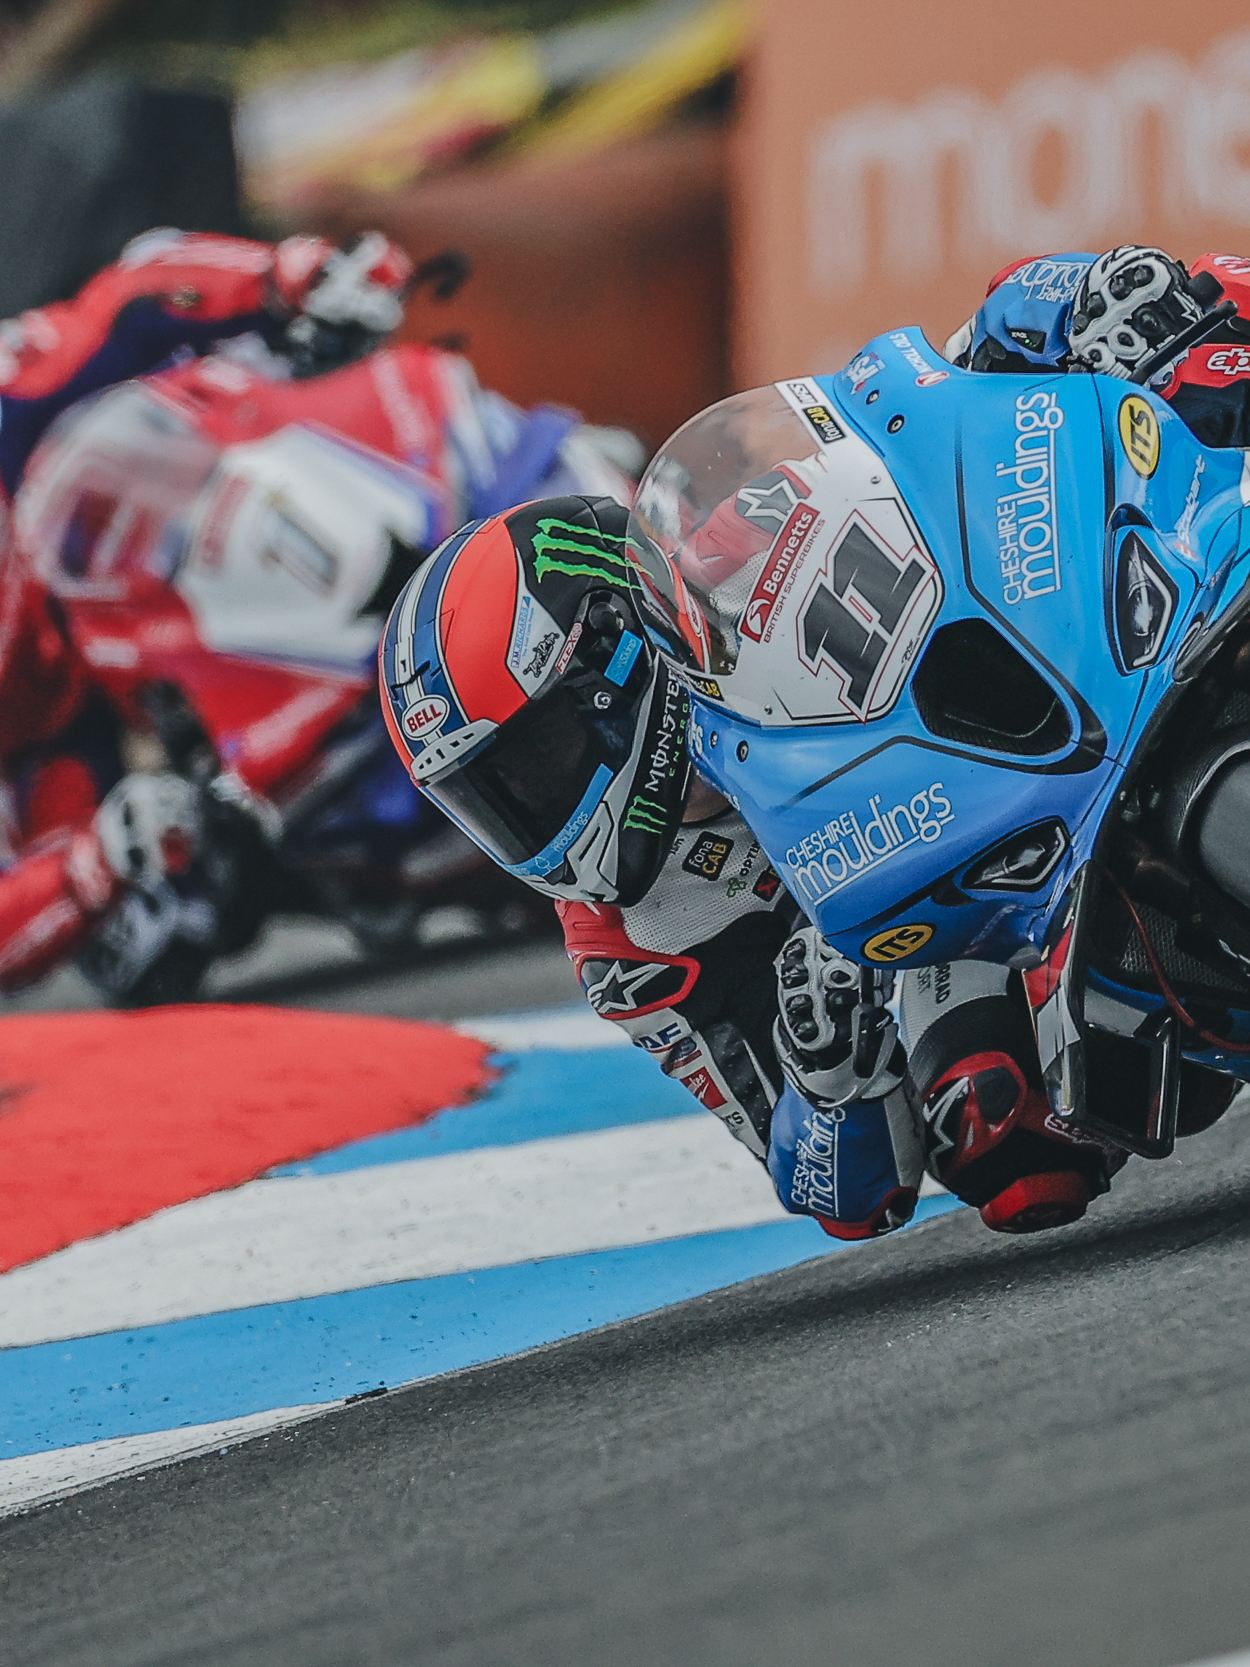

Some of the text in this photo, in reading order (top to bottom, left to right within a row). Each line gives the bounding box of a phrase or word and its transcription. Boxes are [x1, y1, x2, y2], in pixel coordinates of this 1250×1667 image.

[1128, 403, 1152, 468] ITS
[996, 392, 1064, 600] mouldings
[762, 510, 813, 595] Bennetts
[764, 518, 826, 643] BRITISH SUPERBIKES
[996, 500, 1023, 605] CHESHIRE
[804, 522, 927, 710] 11
[556, 636, 578, 674] FLEX
[406, 704, 443, 733] BELL
[669, 693, 689, 777] ENERG
[690, 840, 713, 867] fona
[702, 843, 727, 873] CAB
[786, 810, 855, 868] CHESHIRE
[794, 782, 952, 901] mouldings
[872, 927, 925, 960] ITS
